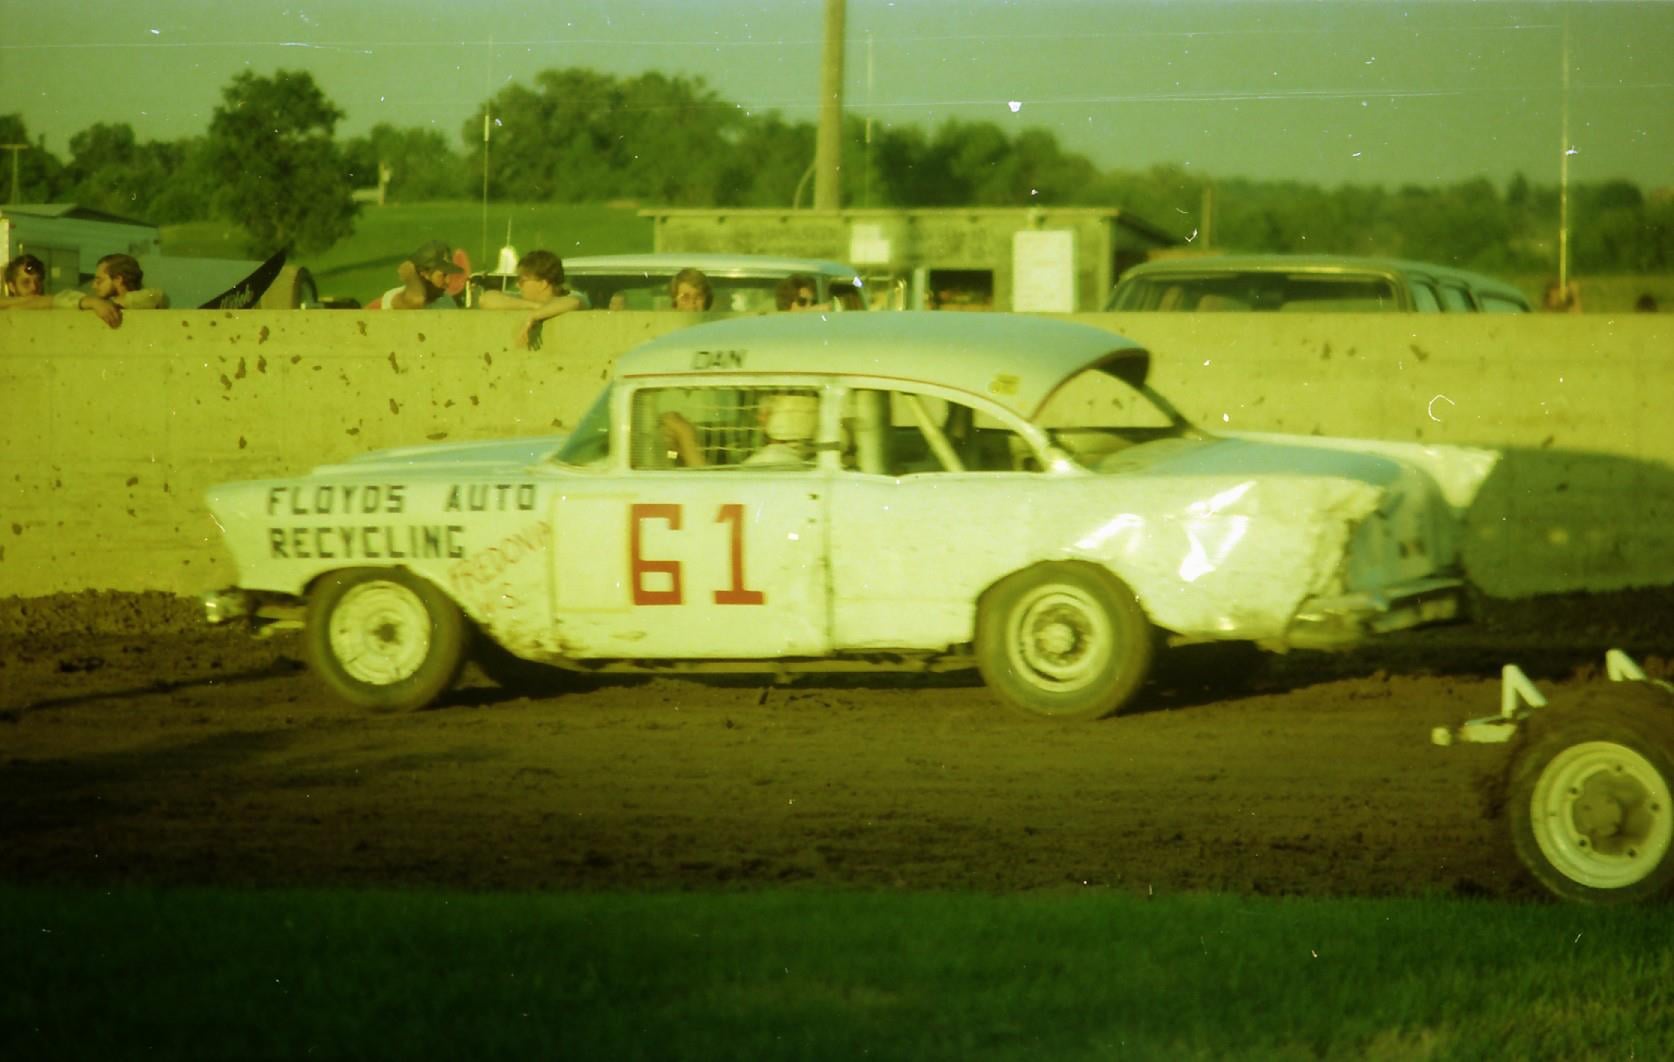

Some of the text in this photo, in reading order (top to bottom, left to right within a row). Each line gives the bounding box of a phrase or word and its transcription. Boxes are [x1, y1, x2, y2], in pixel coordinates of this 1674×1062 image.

[690, 350, 748, 370] DAN
[267, 484, 537, 515] FLOYDS AUTO
[269, 525, 465, 559] RECYCLING
[629, 503, 767, 606] 61
